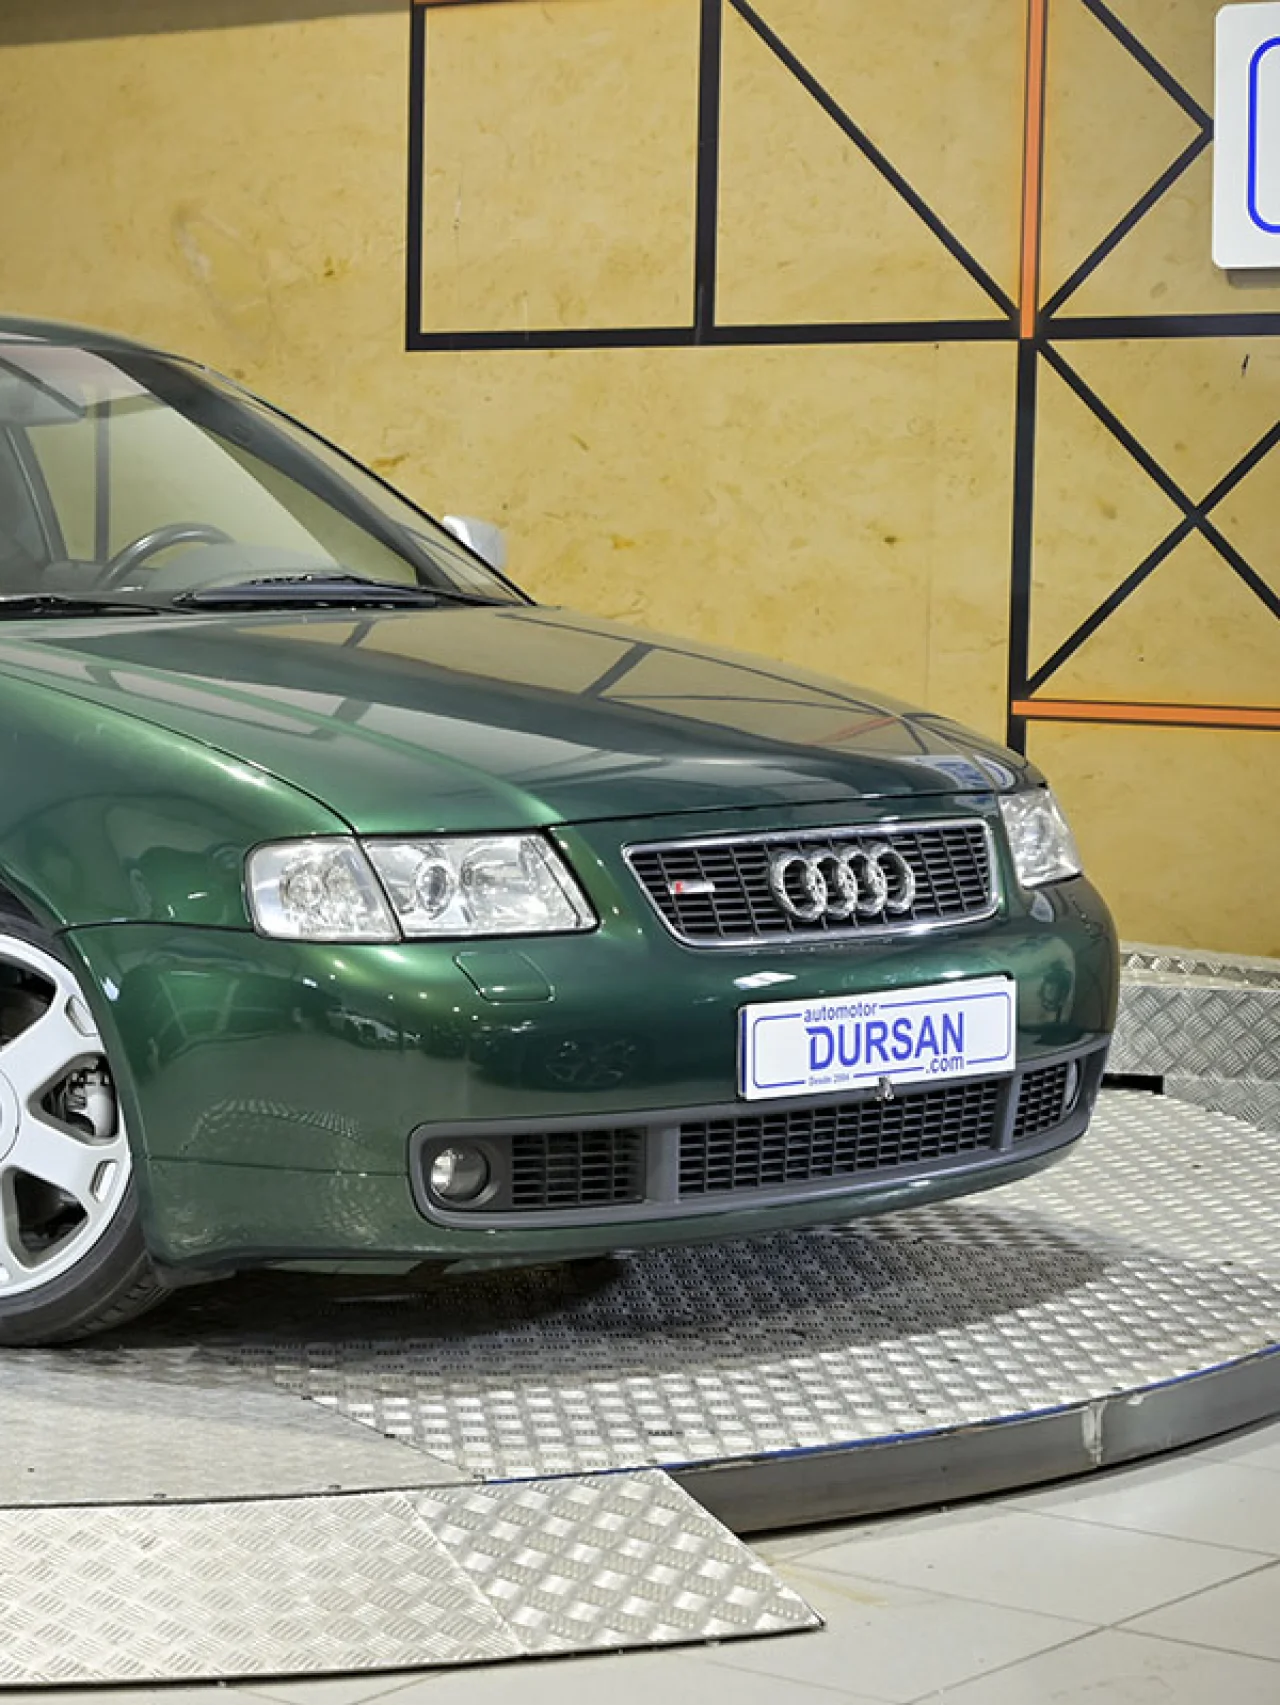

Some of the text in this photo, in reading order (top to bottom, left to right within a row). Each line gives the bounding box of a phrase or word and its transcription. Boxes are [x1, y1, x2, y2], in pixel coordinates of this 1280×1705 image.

[803, 1001, 878, 1023] automotor
[805, 1010, 965, 1071] DURSAN
[925, 1055, 965, 1075] .com
